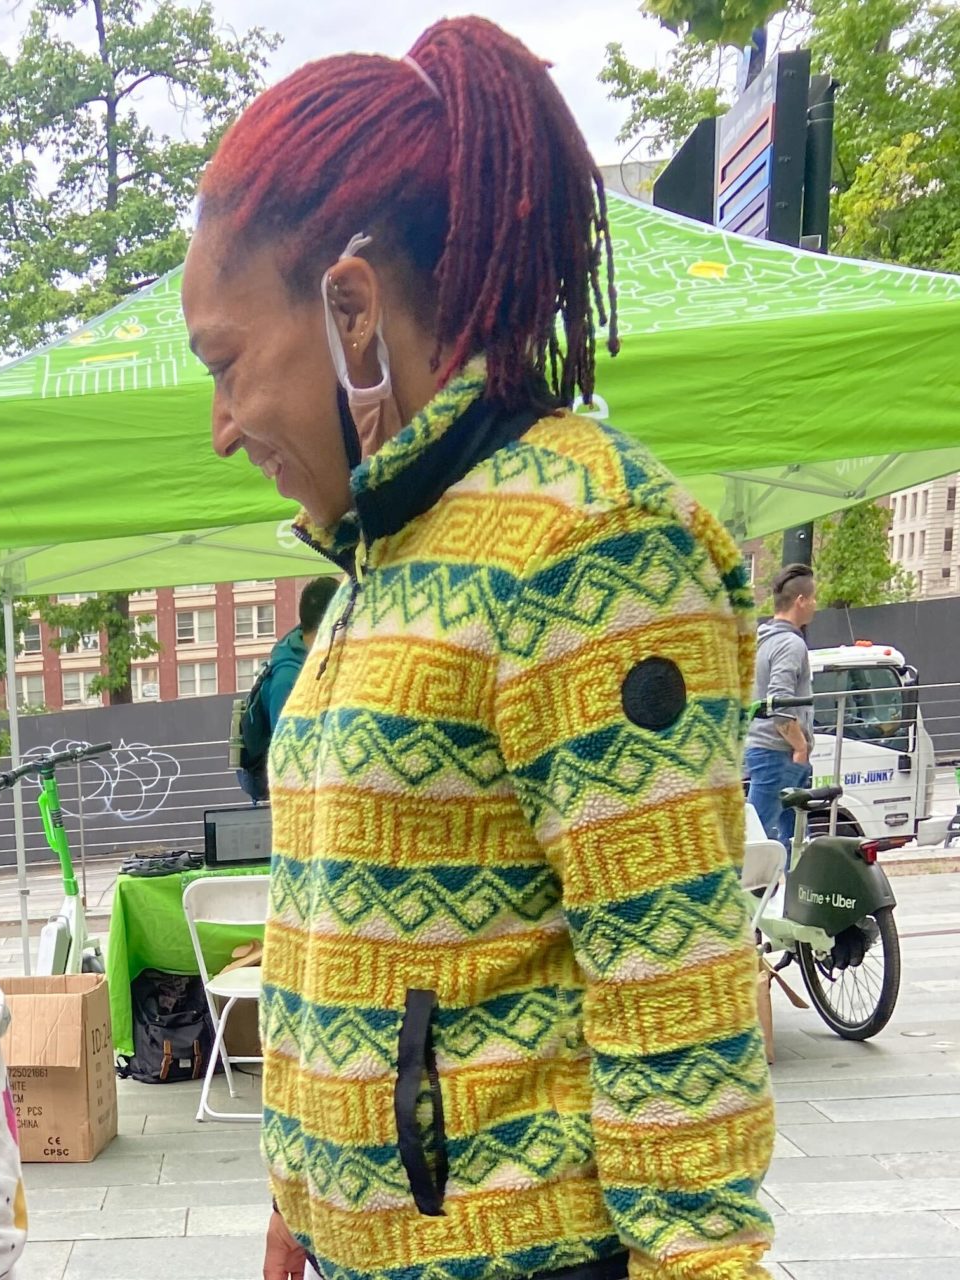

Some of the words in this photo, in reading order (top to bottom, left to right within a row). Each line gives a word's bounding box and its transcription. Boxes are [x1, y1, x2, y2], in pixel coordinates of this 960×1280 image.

[806, 889, 824, 905] Lime
[831, 893, 857, 909] Uber
[27, 1106, 43, 1117] PCS
[43, 1148, 70, 1156] CPSC
